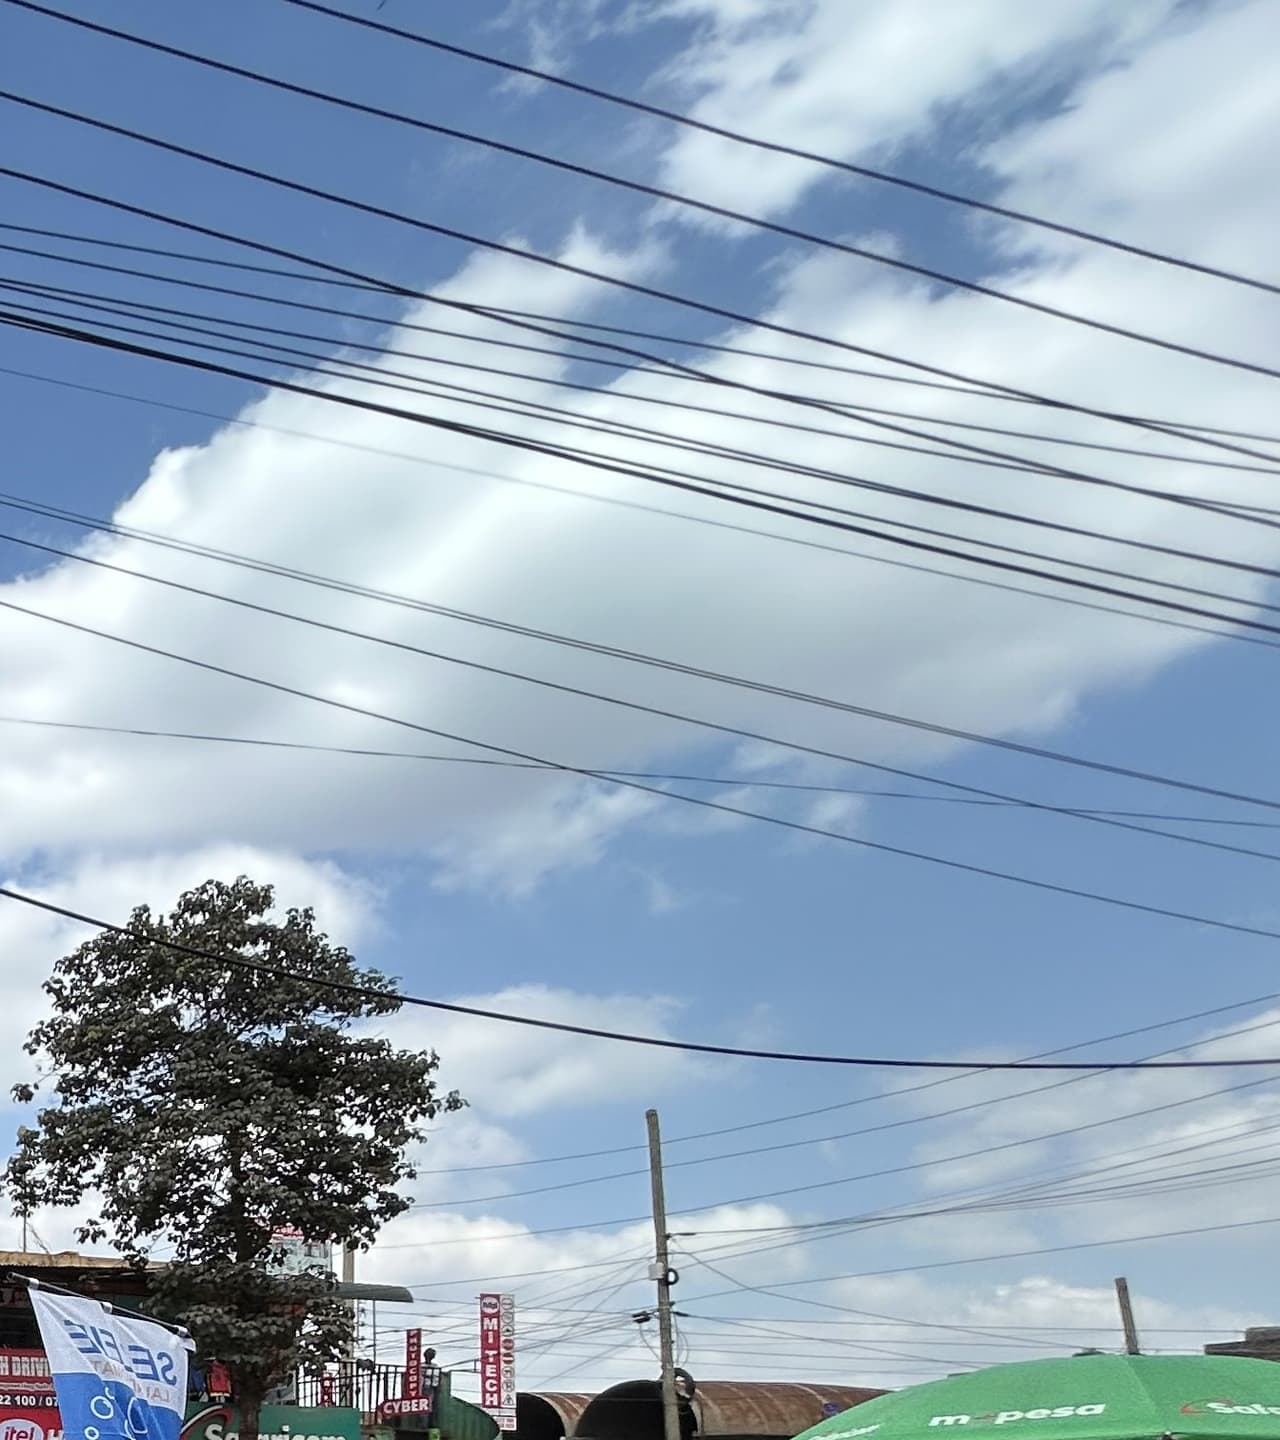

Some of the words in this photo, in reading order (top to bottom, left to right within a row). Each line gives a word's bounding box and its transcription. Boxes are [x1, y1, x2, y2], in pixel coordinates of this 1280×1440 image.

[483, 1317, 498, 1344] MI
[12, 1356, 52, 1378] DRIVI
[483, 1350, 498, 1406] TECH
[15, 1396, 36, 1407] 100
[45, 1398, 59, 1408] 07
[383, 1399, 430, 1414] CYBER
[1206, 1402, 1280, 1415] Safa
